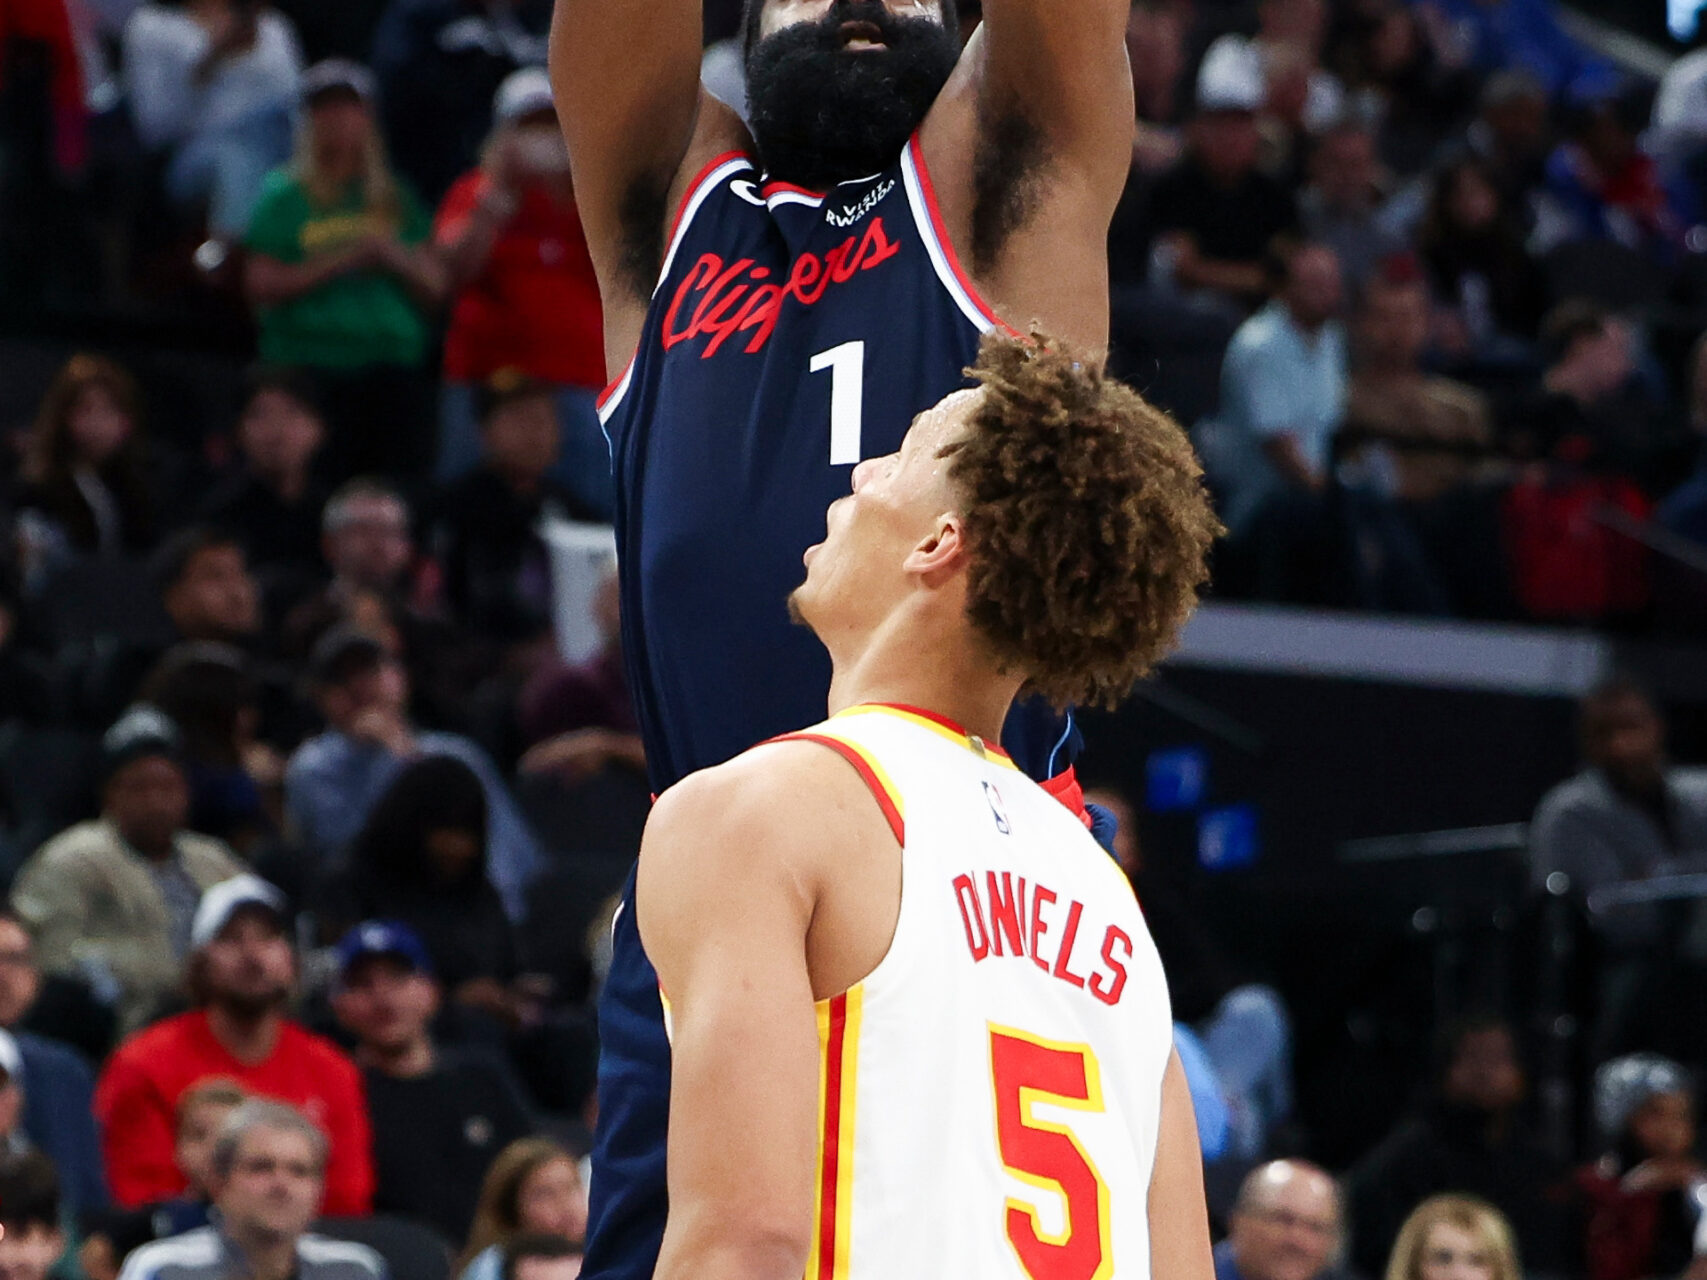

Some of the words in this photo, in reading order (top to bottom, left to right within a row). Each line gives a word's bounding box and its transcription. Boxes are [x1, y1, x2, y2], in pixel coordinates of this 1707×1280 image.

[826, 179, 895, 227] RWANDA
[843, 181, 884, 217] VISIT
[810, 340, 864, 465] 1
[952, 870, 1133, 1006] DNIELS
[985, 1020, 1114, 1280] 5
